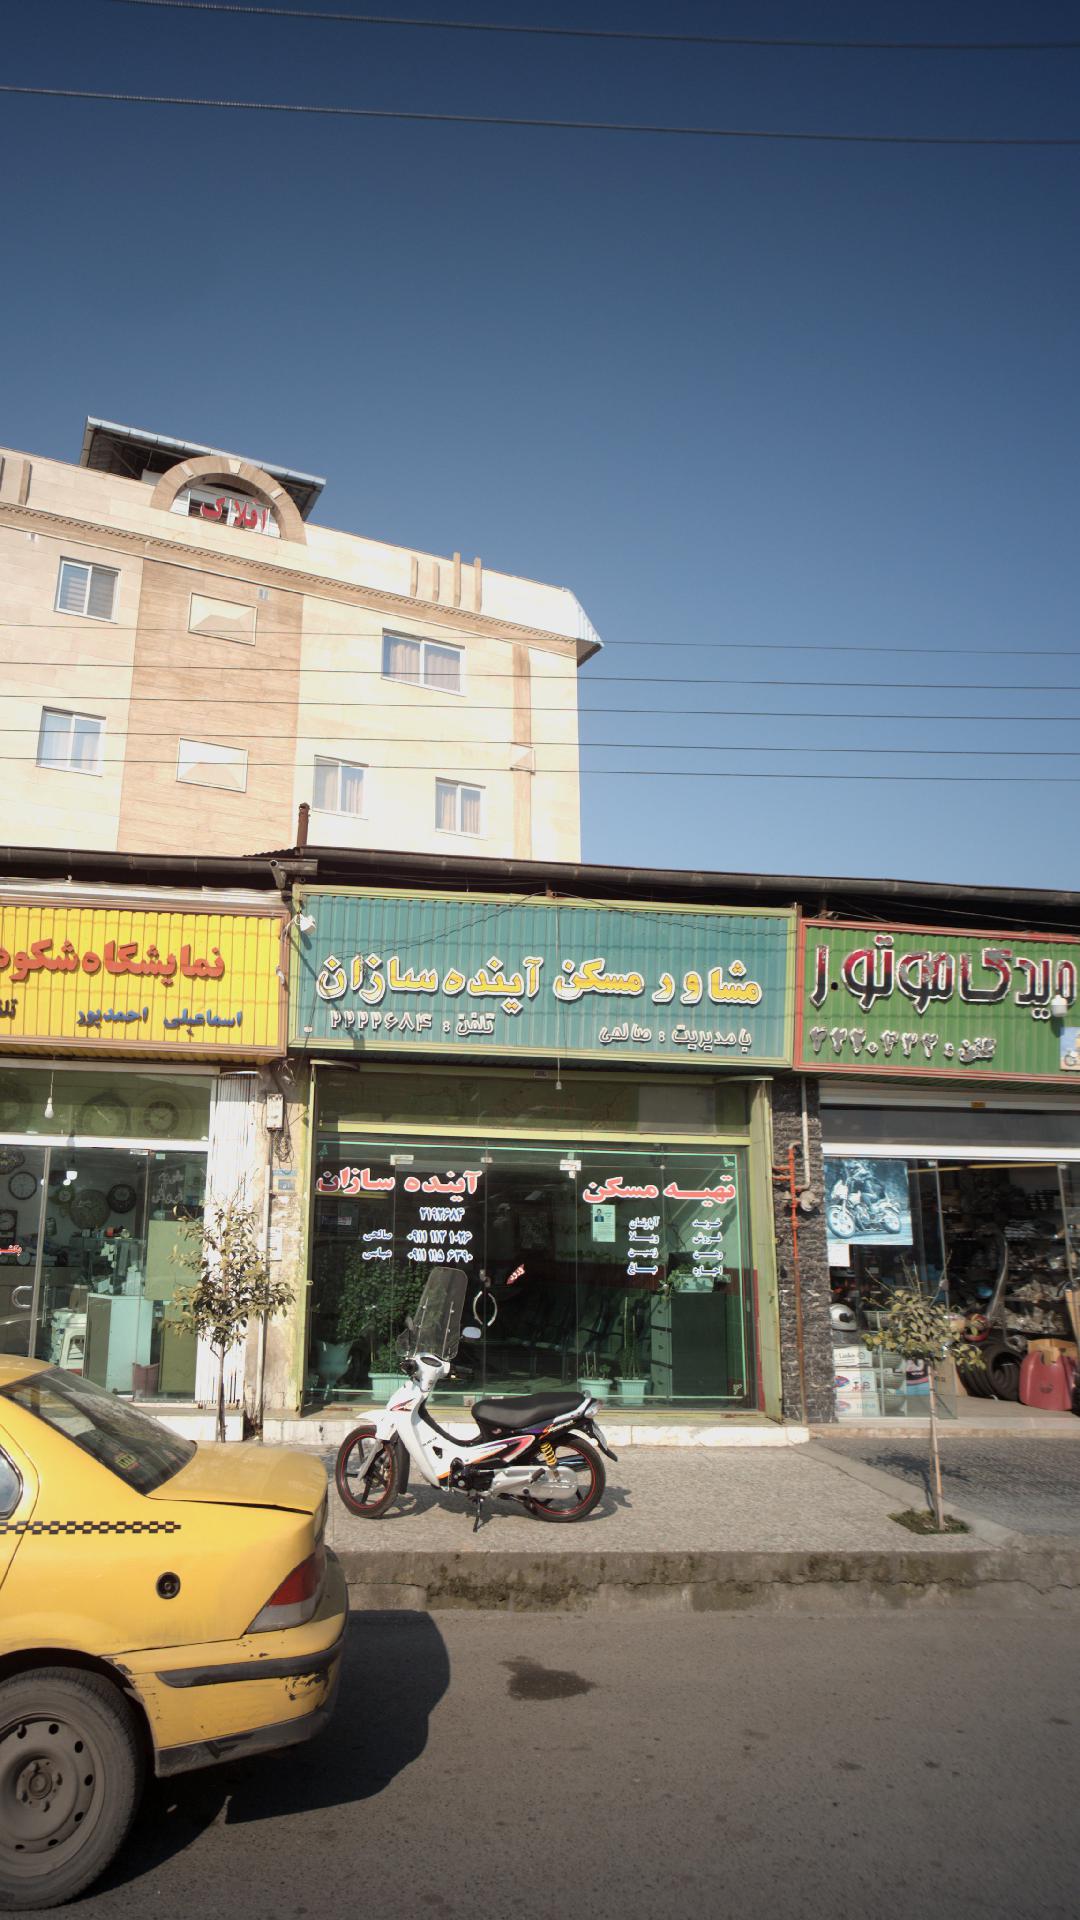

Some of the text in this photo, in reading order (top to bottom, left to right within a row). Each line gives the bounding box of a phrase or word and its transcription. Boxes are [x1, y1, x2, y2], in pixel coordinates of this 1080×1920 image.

[200, 496, 269, 532] افلاک
[82, 940, 225, 986] نمایشگاه
[809, 935, 955, 1014] موتور
[316, 953, 762, 1014] مشاور مسکن آینده سازان
[164, 1008, 242, 1035] اسماعیلی
[456, 1012, 496, 1036] تلفن
[599, 1022, 652, 1042] صالحی
[316, 1167, 395, 1194] سازان
[404, 1170, 482, 1202] آینده
[583, 1174, 736, 1207] تهیه مسکن
[363, 1229, 393, 1241] صالحی
[628, 1215, 660, 1230] آپارتمان
